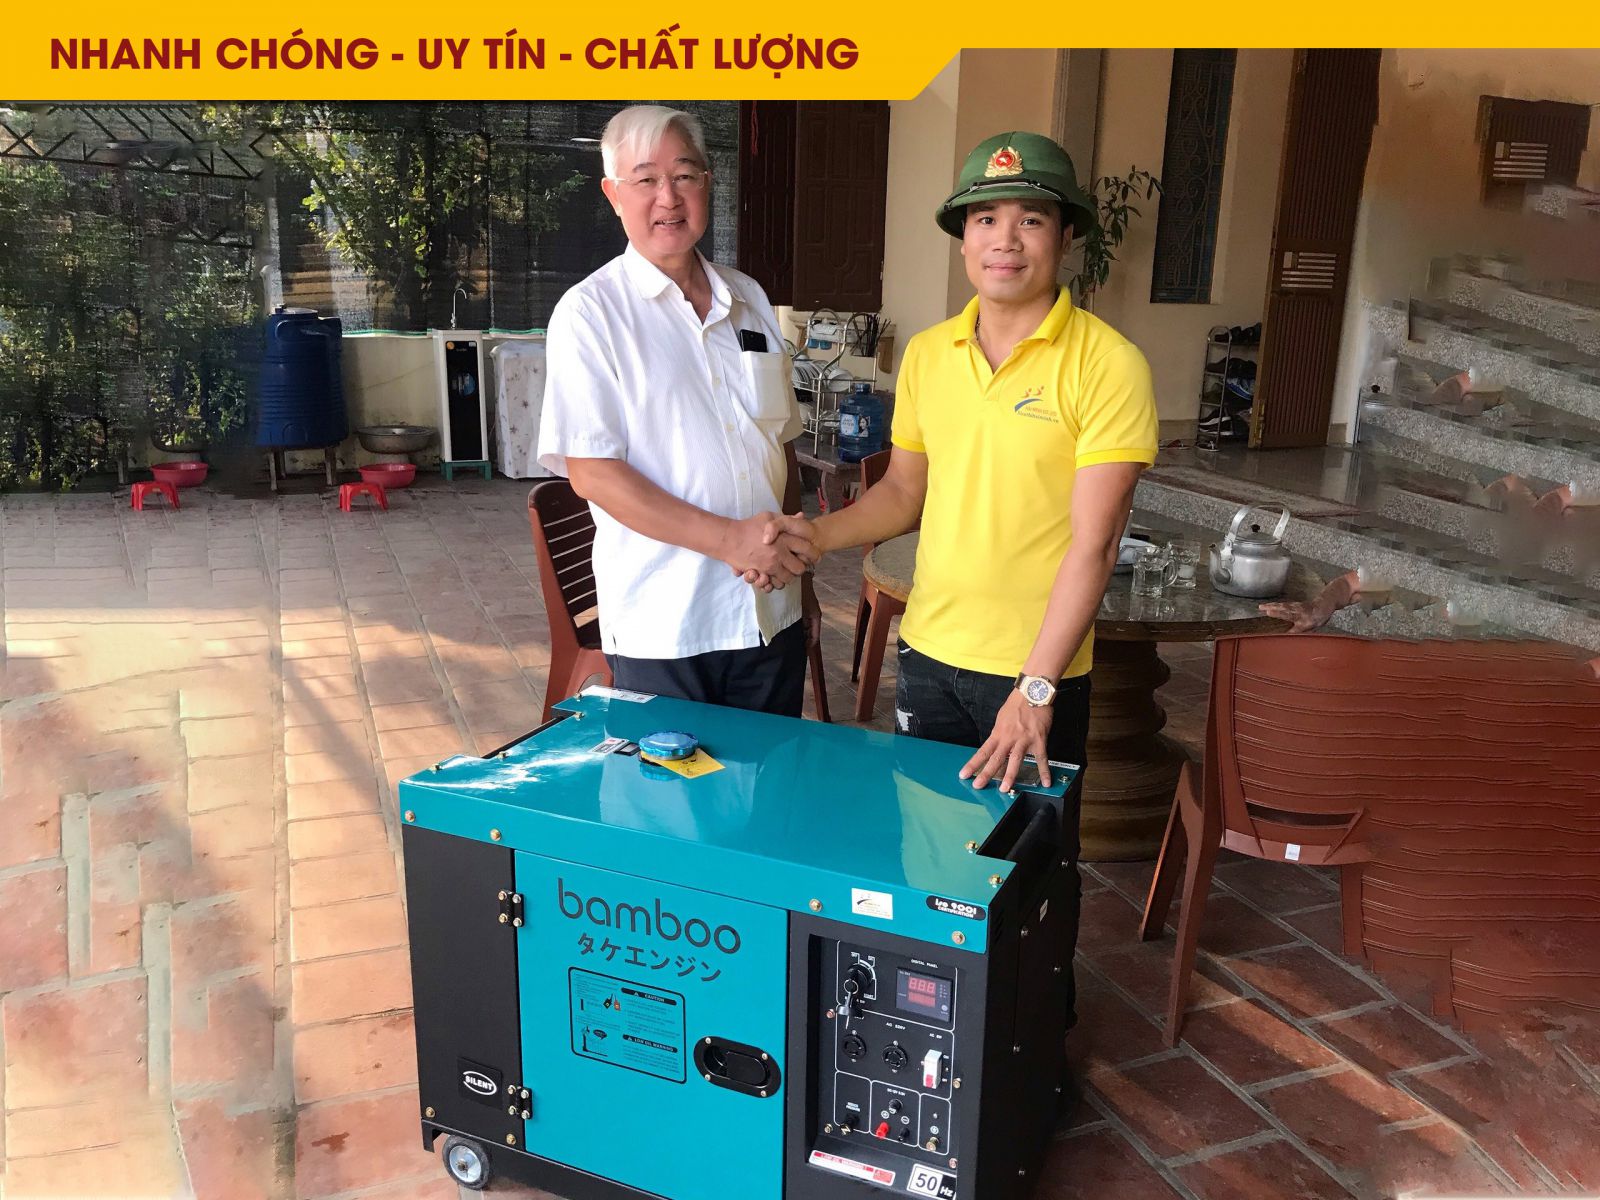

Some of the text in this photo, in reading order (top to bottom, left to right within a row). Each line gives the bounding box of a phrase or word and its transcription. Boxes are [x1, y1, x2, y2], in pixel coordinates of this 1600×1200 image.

[558, 877, 741, 954] bamboo
[951, 902, 977, 915] 9001
[578, 932, 721, 982] タケエンジン
[465, 1075, 492, 1090] SILENT
[915, 1173, 954, 1197] 50 Hz
